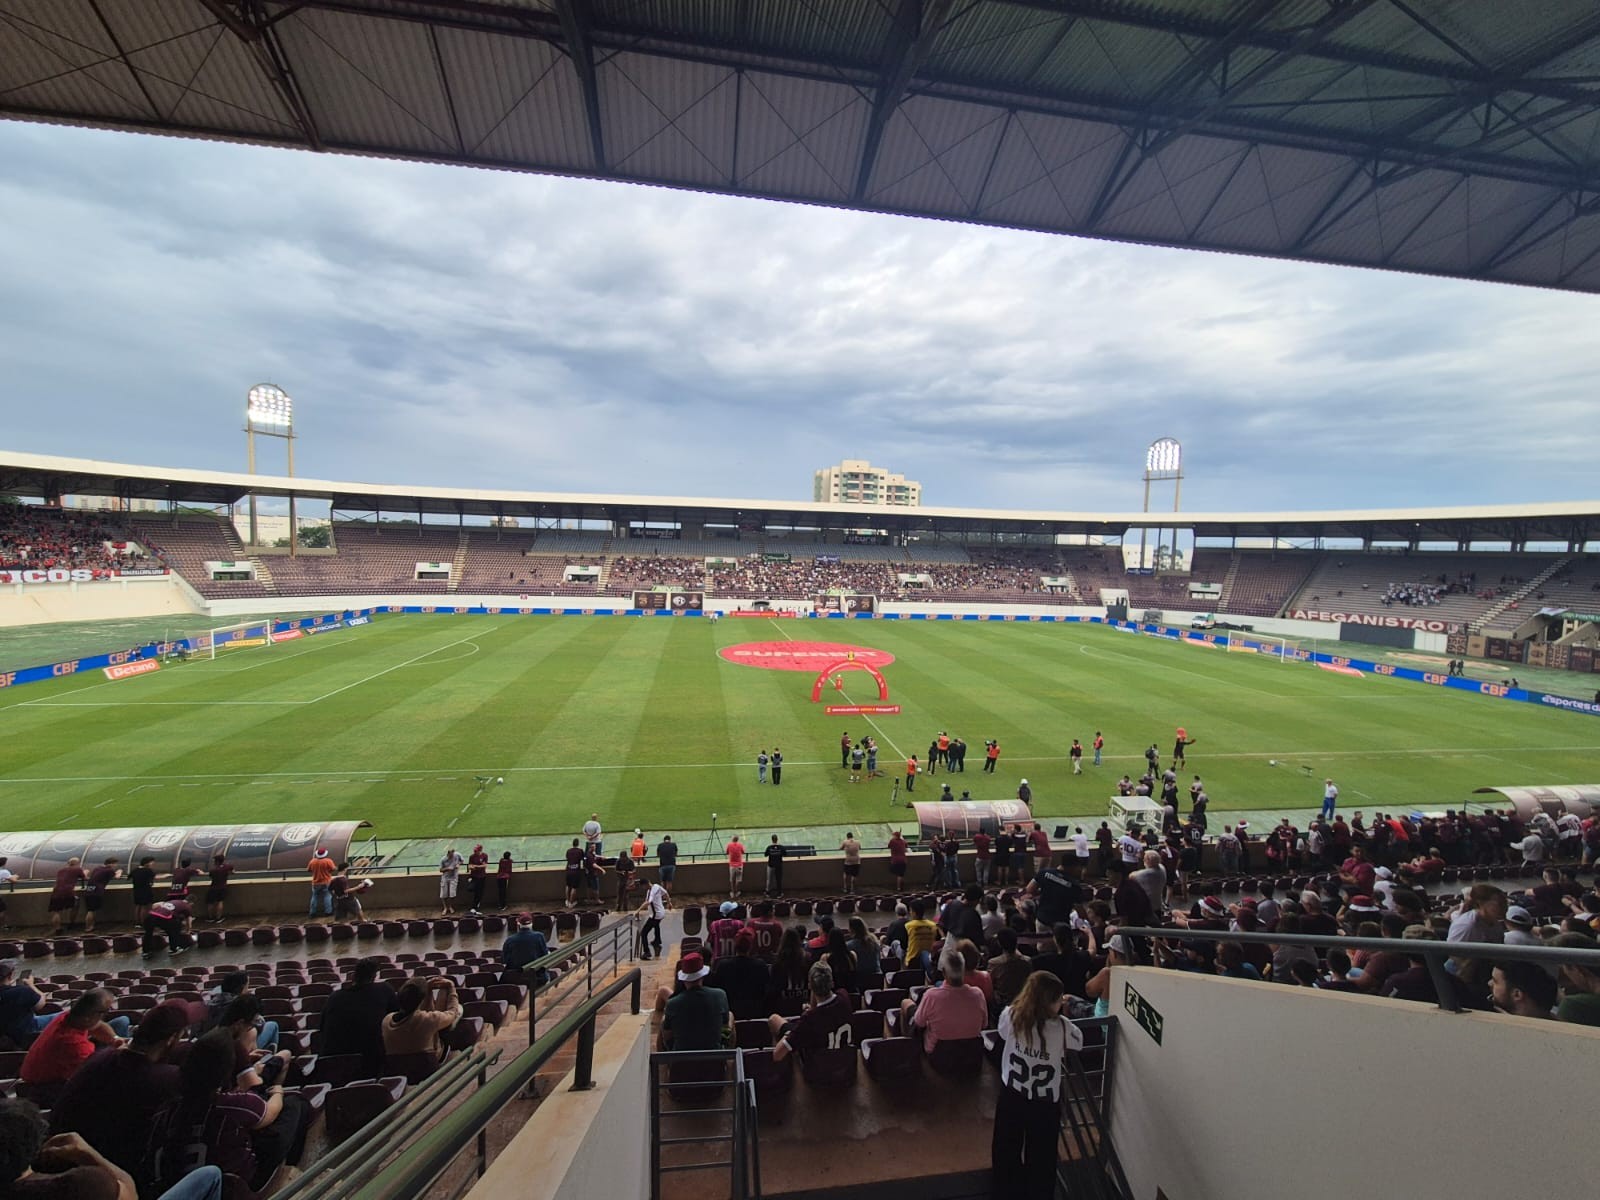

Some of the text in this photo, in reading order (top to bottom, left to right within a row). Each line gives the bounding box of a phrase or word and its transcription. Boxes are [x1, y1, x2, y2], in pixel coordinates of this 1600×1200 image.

[1204, 634, 1215, 642] CBF
[157, 641, 176, 654] CBF
[1260, 644, 1275, 652] CBF
[1294, 648, 1310, 659] CBF
[109, 648, 132, 664] CBF
[1332, 656, 1351, 666] CBF
[52, 660, 79, 676] CBF
[114, 662, 156, 677] Betano
[1374, 664, 1396, 675] CBF
[1423, 672, 1448, 685] CBF
[1480, 683, 1509, 696] CBF
[1192, 829, 1200, 840] 10
[1123, 841, 1134, 854] 10
[756, 930, 771, 947] 10
[1024, 1048, 1050, 1060] ALVES
[1008, 1052, 1056, 1098] 22
